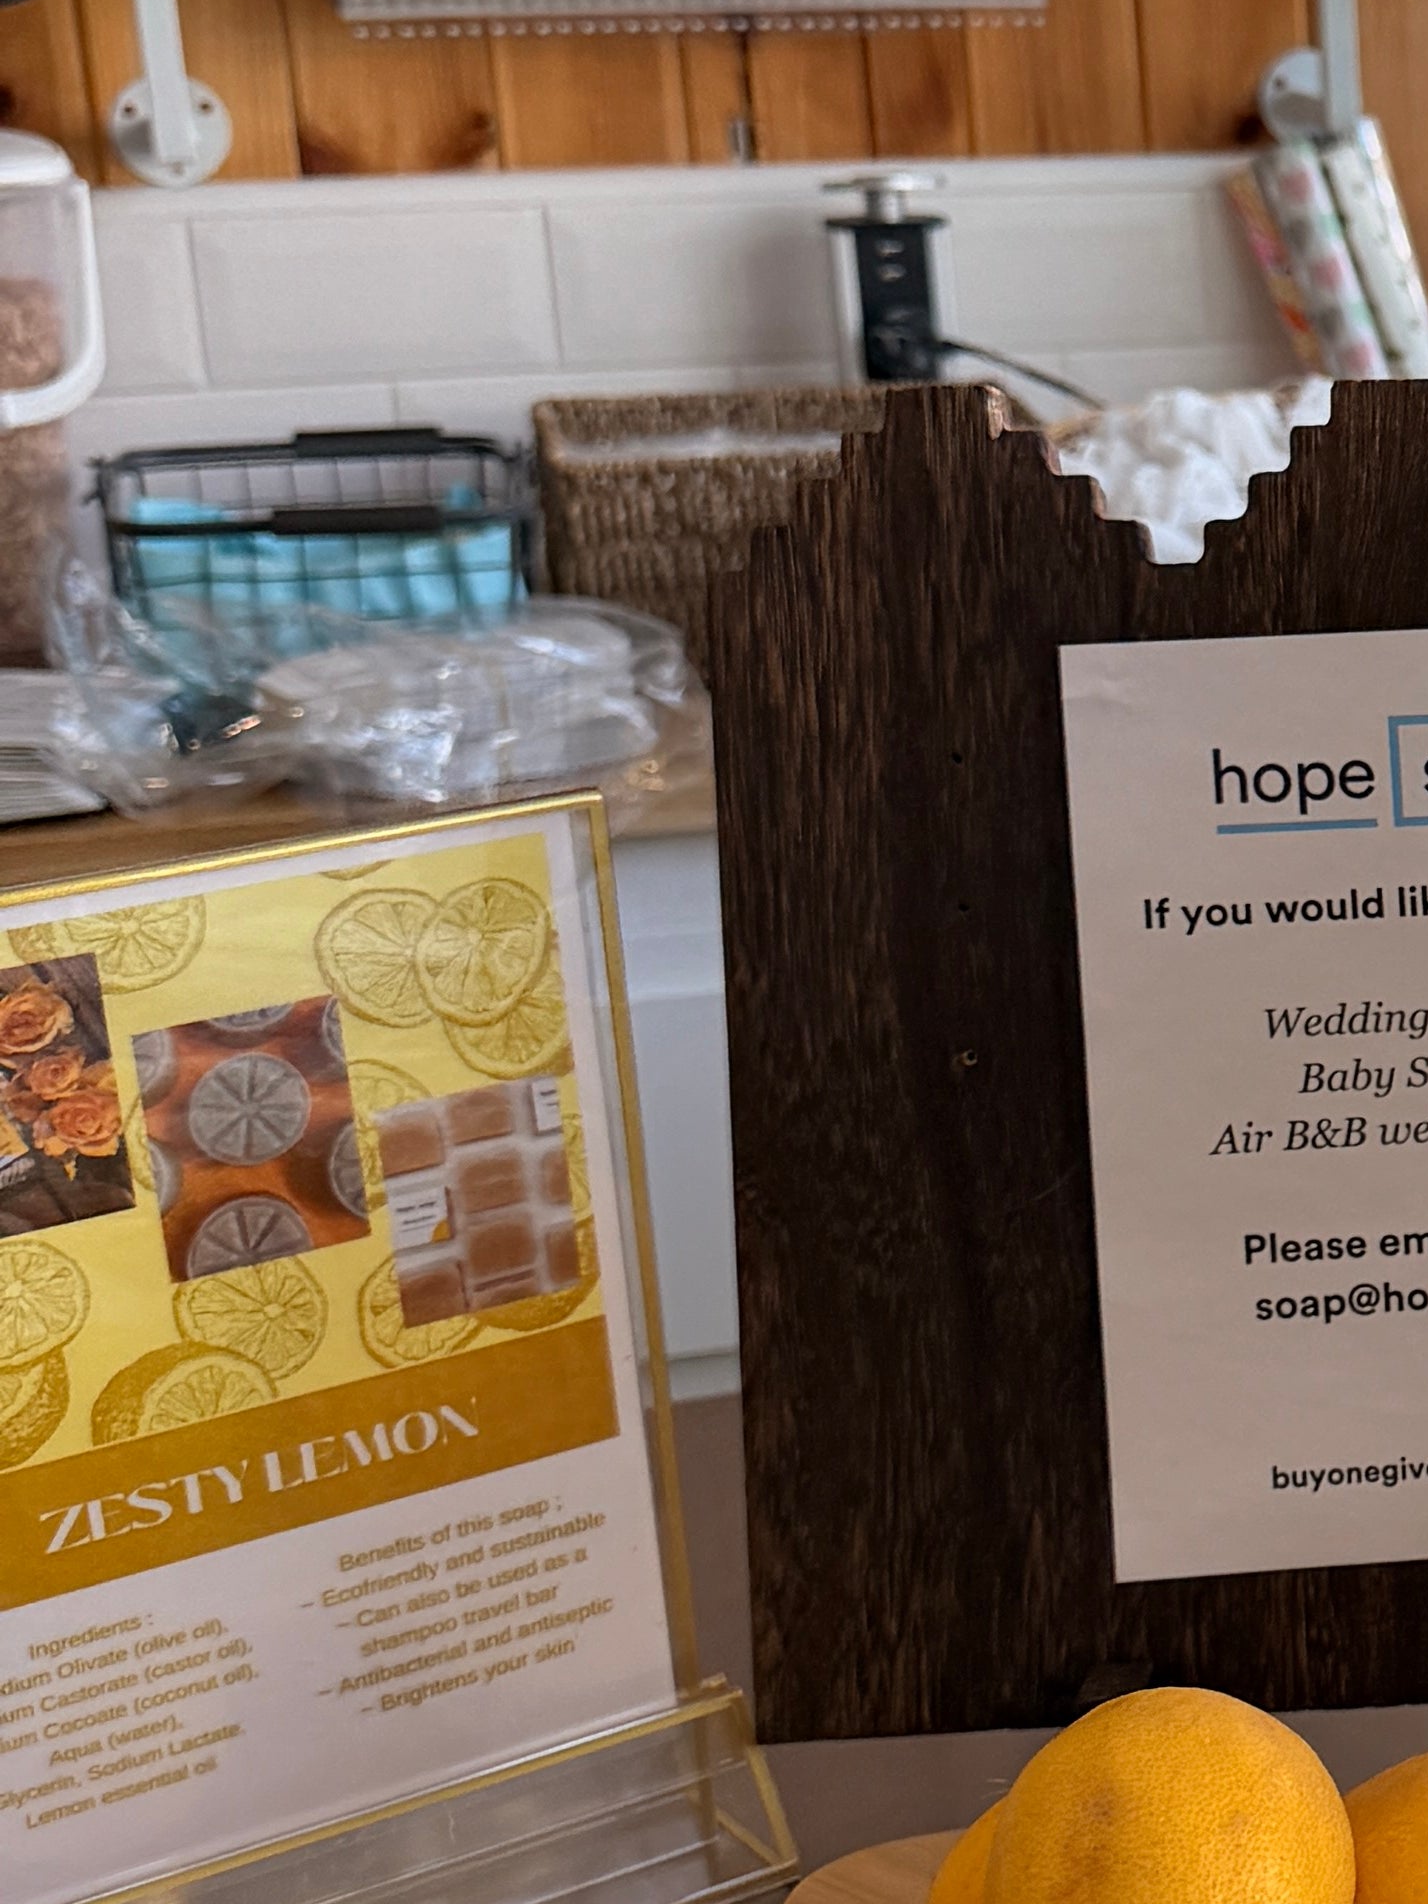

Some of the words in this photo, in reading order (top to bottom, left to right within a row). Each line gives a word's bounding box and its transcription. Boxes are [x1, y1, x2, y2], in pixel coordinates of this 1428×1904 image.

[1211, 749, 1376, 815] hope
[1144, 898, 1170, 931] If
[1182, 897, 1253, 937] you
[1265, 886, 1384, 925] would
[1299, 1061, 1396, 1099] Baby
[1210, 1120, 1273, 1157] Air
[1284, 1116, 1367, 1152] B&B
[1243, 1230, 1367, 1267] Please
[39, 1459, 248, 1555] ZESTY
[264, 1397, 479, 1493] LEMON
[321, 1559, 439, 1607] Ecofriendly
[446, 1547, 485, 1571] and
[490, 1511, 606, 1559] sustainable
[338, 1534, 426, 1572] Benefits
[431, 1524, 451, 1545] of
[457, 1516, 494, 1537] this
[499, 1497, 549, 1527] soap
[356, 1603, 400, 1627] Can
[406, 1588, 450, 1614] also
[456, 1575, 481, 1598] be
[487, 1559, 538, 1589] used
[544, 1555, 569, 1572] as
[28, 1615, 143, 1660] Ingredients
[338, 1640, 468, 1694] Antibacterial
[473, 1626, 512, 1652] and
[517, 1596, 615, 1638] antiseptic
[359, 1615, 457, 1660] shampoo
[463, 1594, 520, 1625] travel
[526, 1585, 559, 1606] bar
[57, 1650, 128, 1680] Olivate
[379, 1667, 478, 1712] Brightens
[483, 1652, 528, 1683] your
[534, 1638, 575, 1664] skin
[40, 1672, 138, 1713] Castorate
[48, 1738, 102, 1766] Aqua
[87, 1747, 163, 1781] Sodium
